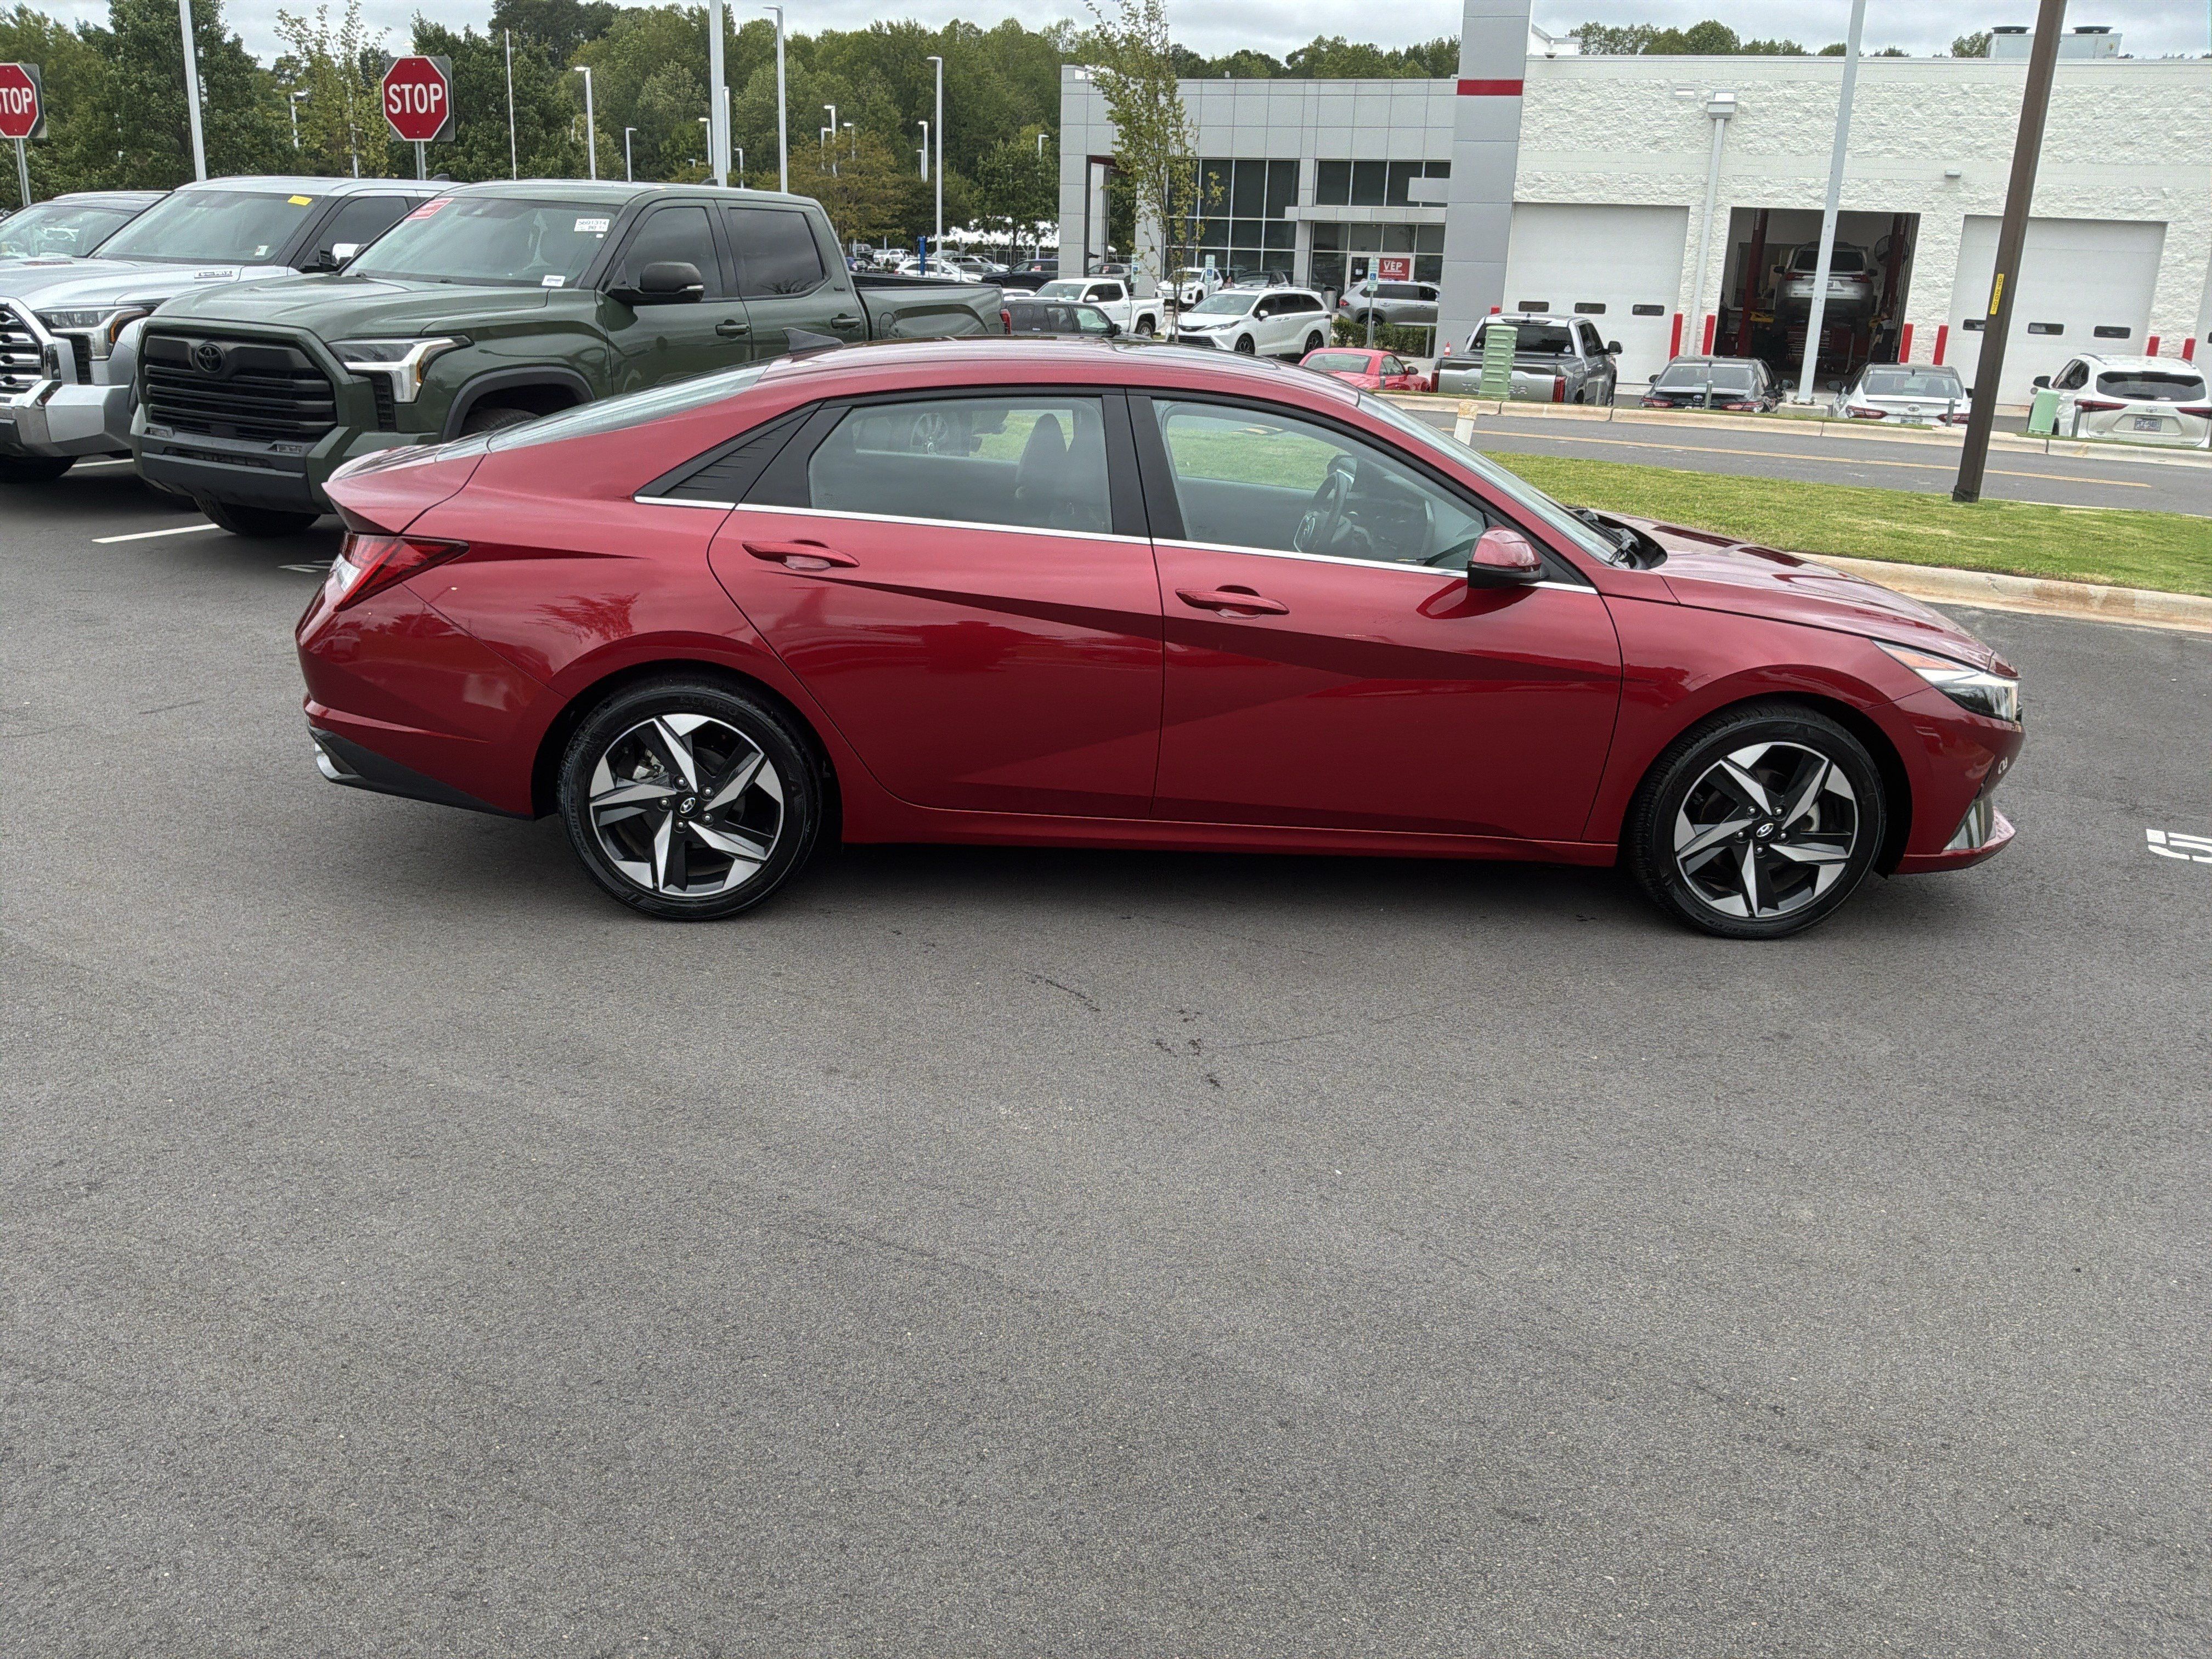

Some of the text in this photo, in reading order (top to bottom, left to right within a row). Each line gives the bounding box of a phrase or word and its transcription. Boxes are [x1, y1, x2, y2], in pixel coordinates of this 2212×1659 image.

[0, 87, 32, 114] TOP
[388, 83, 443, 114] STOP
[1383, 261, 1403, 271] VEP
[1462, 382, 1528, 394] TURA
